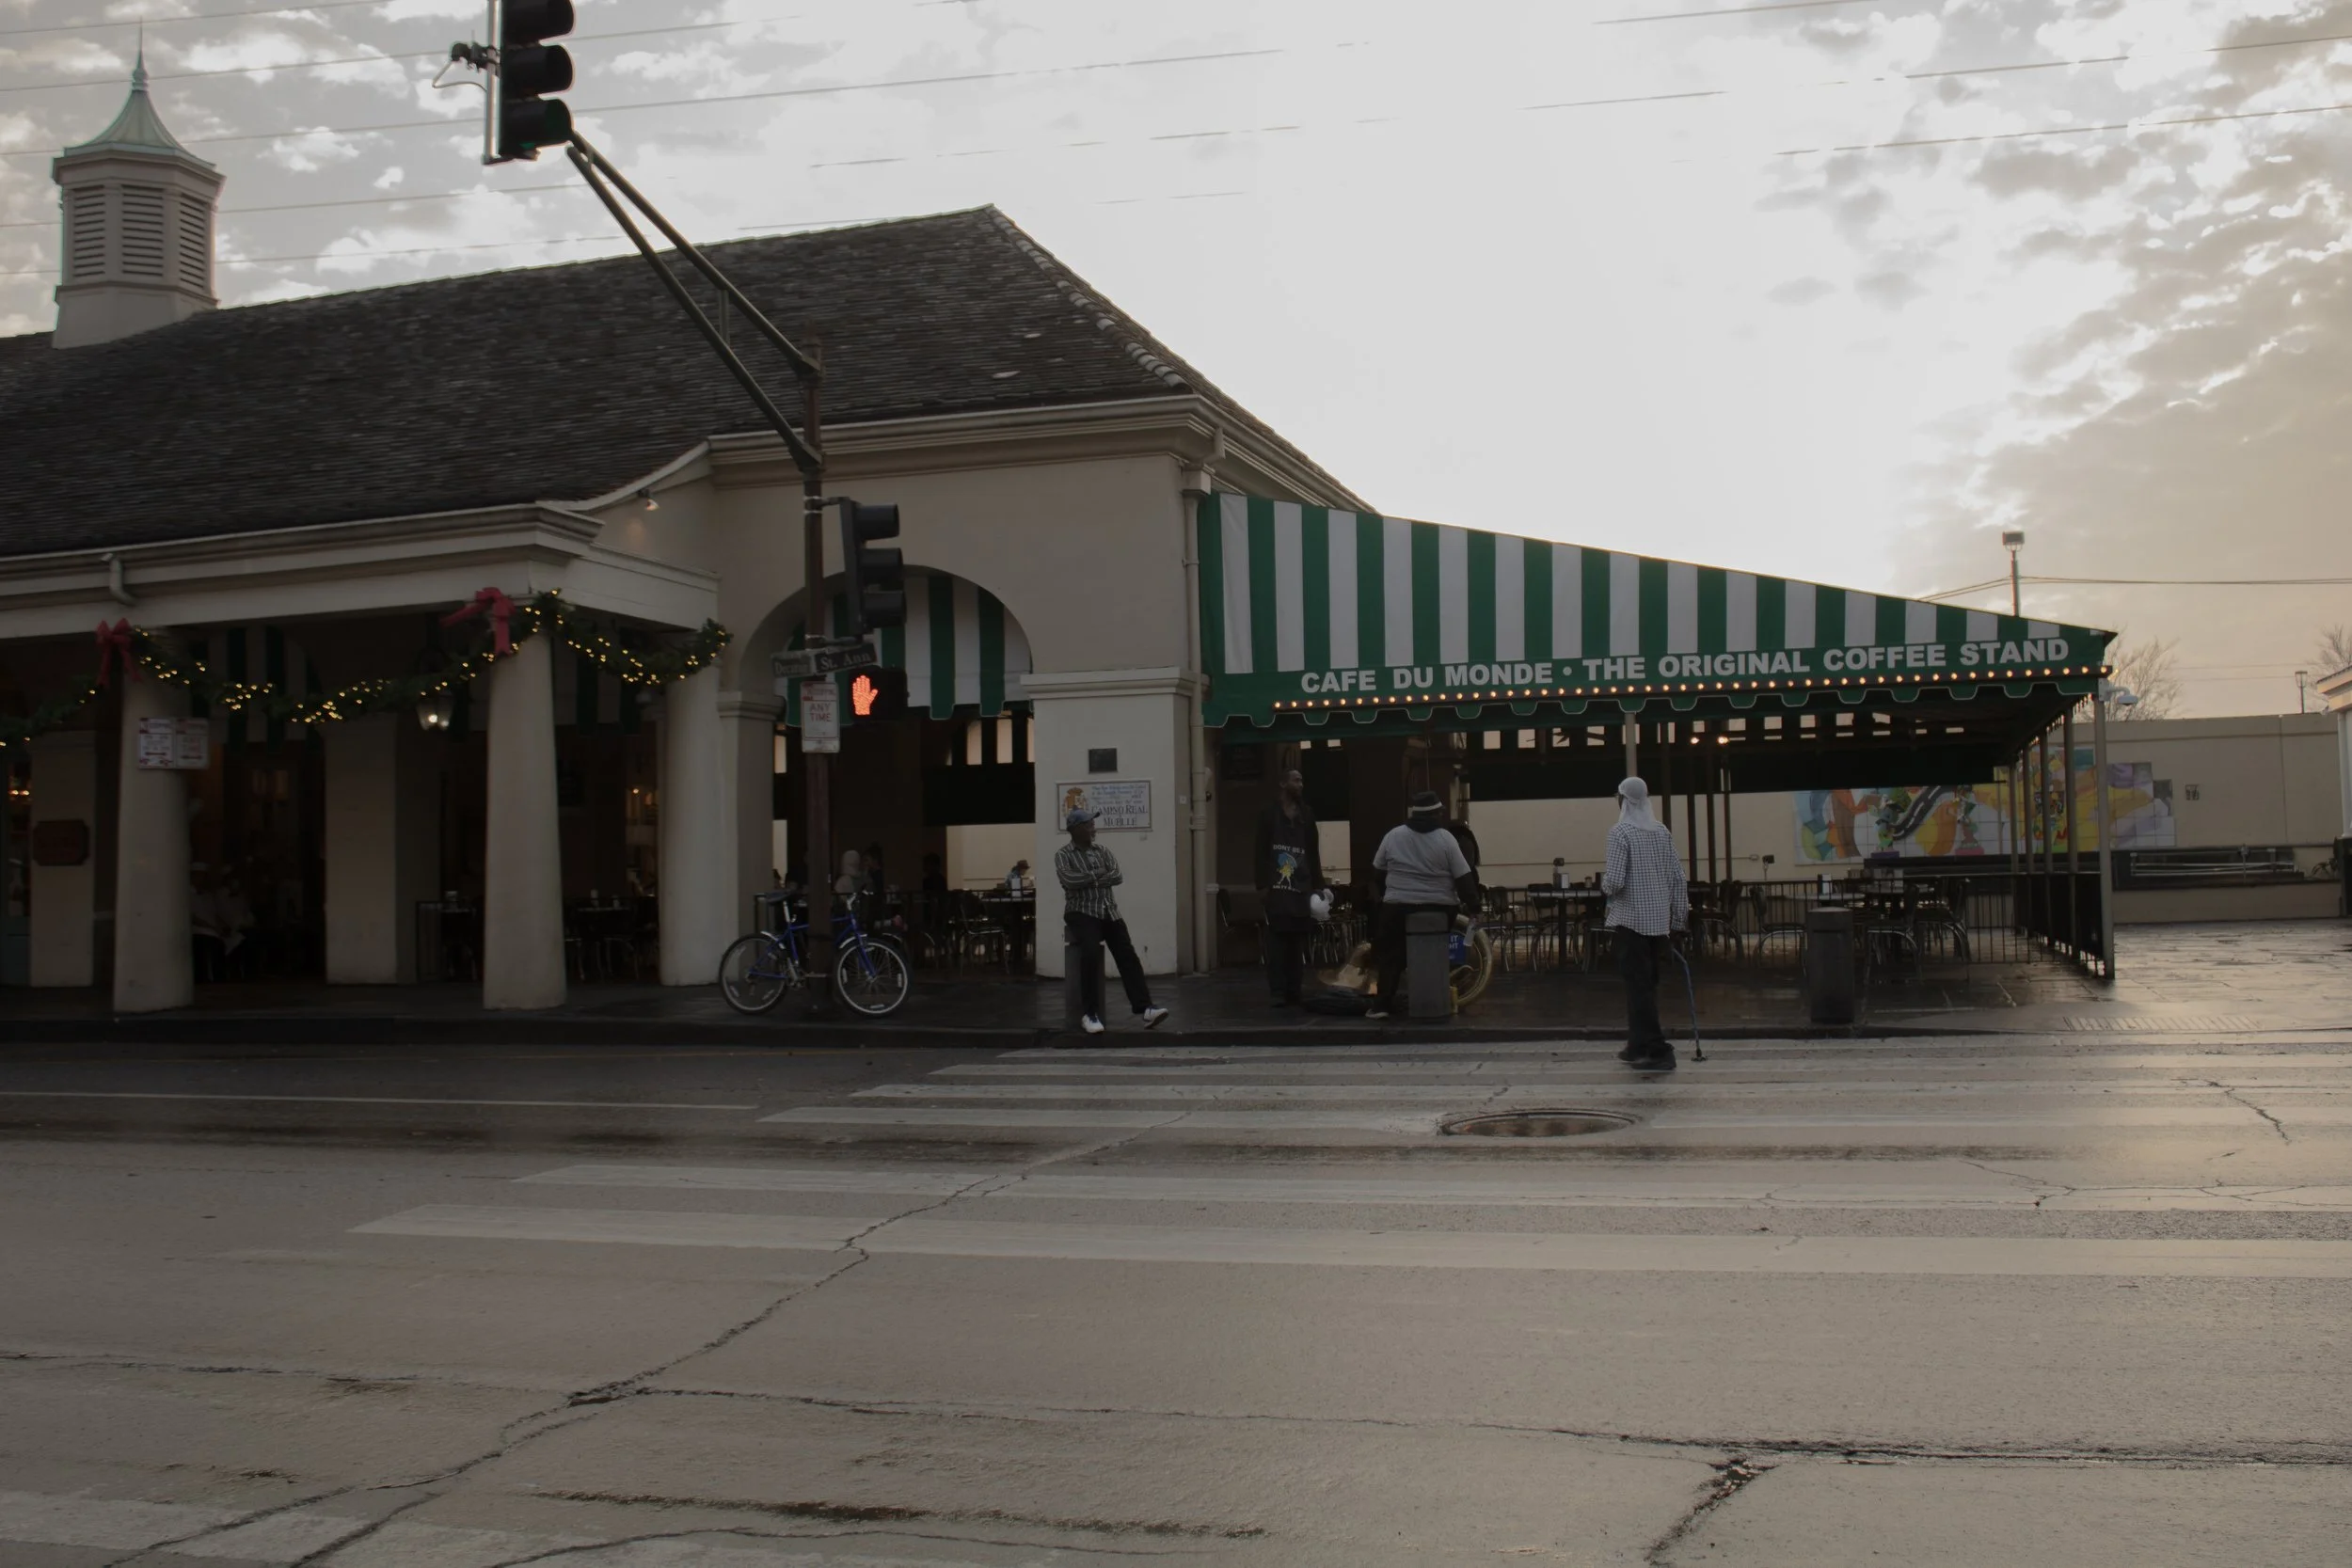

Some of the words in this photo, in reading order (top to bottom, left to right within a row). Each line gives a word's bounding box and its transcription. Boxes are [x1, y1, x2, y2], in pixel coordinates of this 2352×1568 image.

[820, 657, 838, 671] St.
[843, 652, 871, 666] Ann
[1301, 670, 1376, 693] CAFE
[1393, 667, 1433, 689] DU
[1444, 664, 1552, 687] MONDE
[1582, 657, 1645, 681] THE
[1658, 652, 1810, 677] ORIGINAL
[1823, 644, 1946, 671] COFFEE
[1960, 639, 2069, 666] STAND
[810, 703, 832, 712] ANY
[810, 713, 833, 722] TIME
[1125, 804, 1148, 815] REAL
